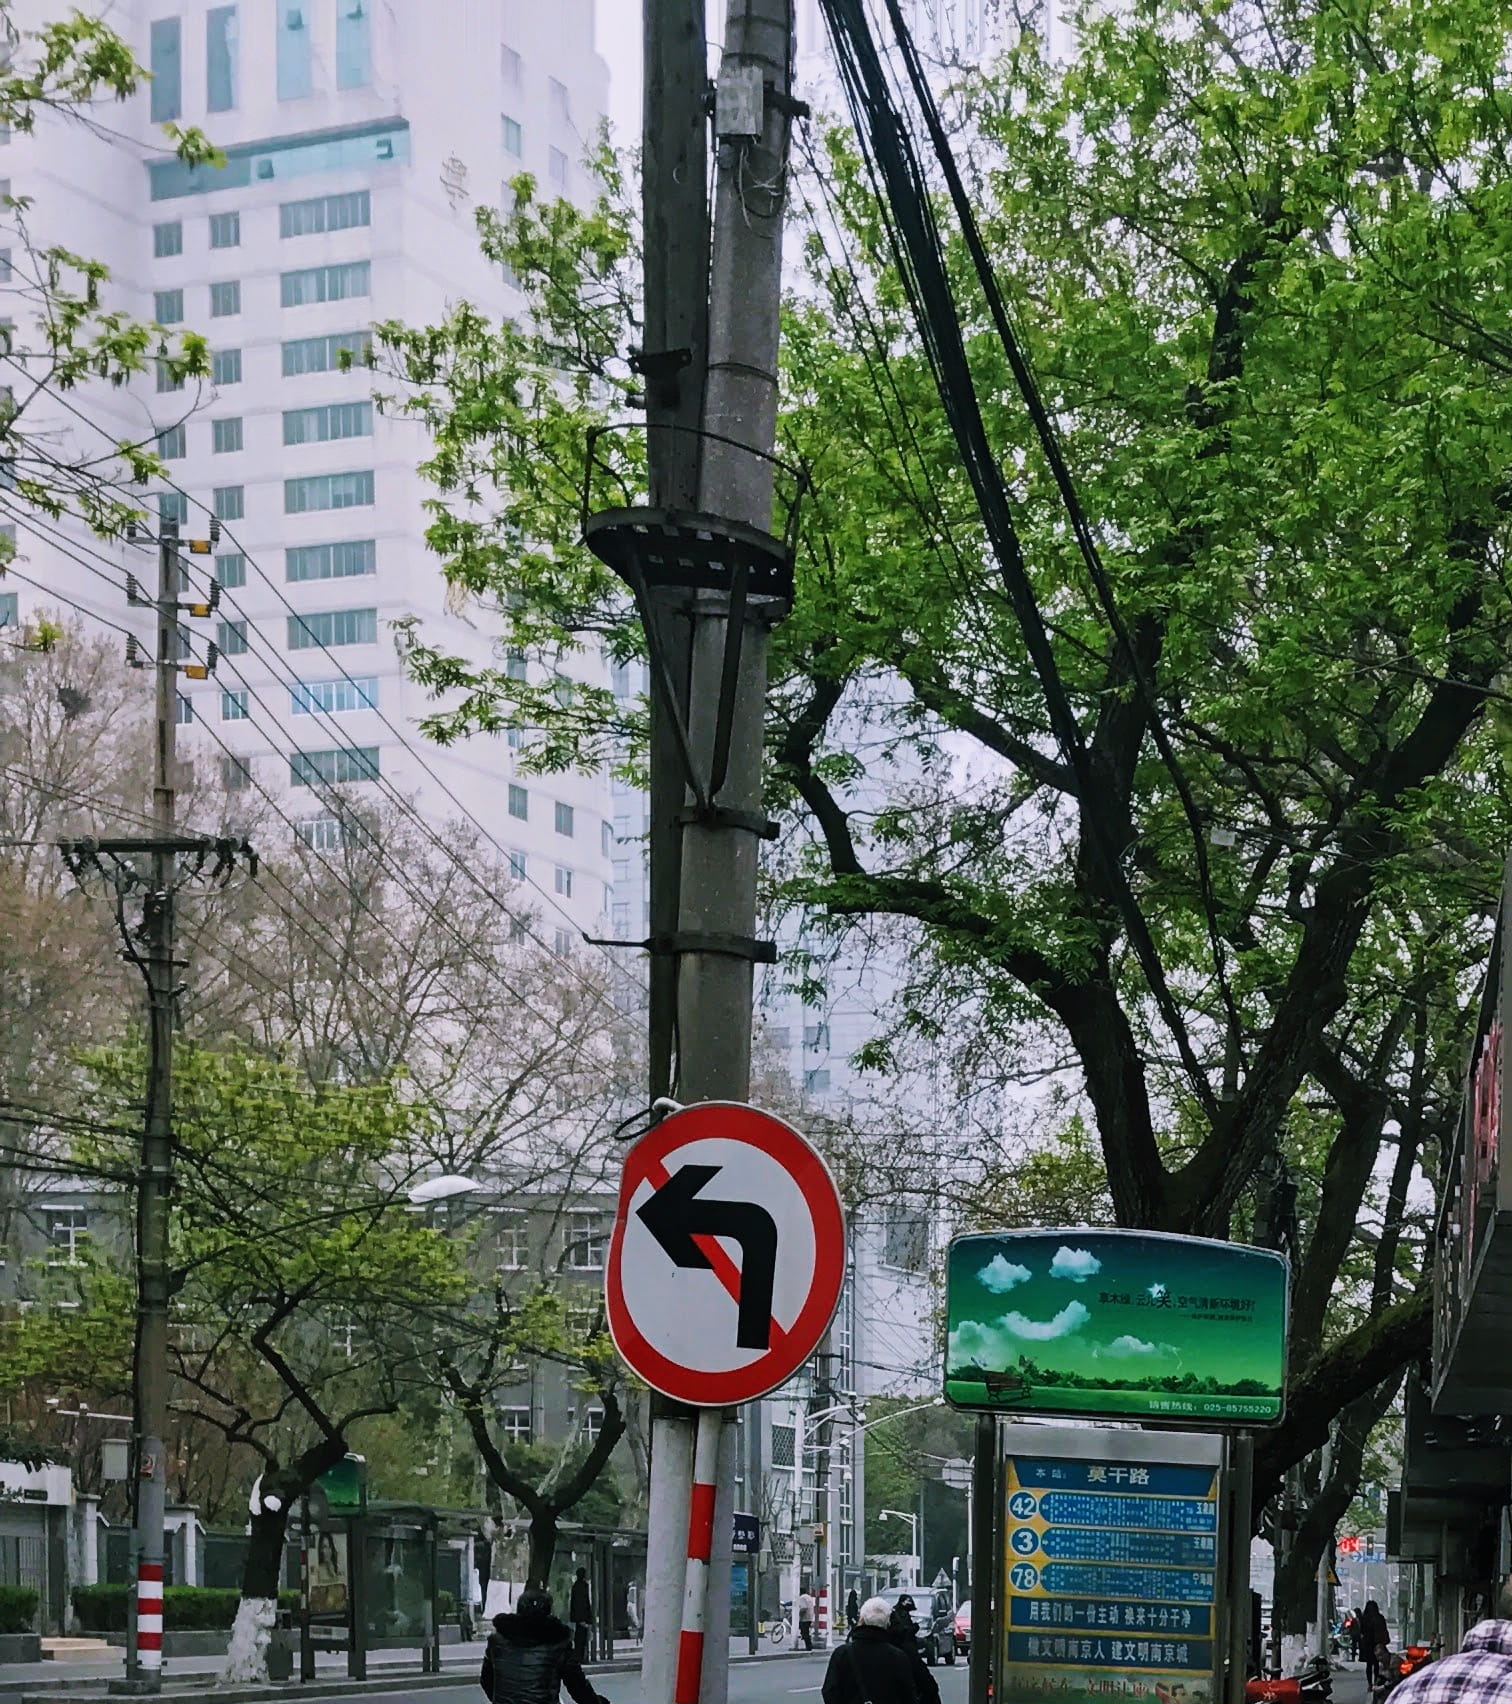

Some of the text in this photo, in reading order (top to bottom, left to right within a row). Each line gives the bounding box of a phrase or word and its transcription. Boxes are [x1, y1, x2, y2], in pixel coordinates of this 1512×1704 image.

[1087, 1466, 1151, 1486] 莫干路
[1012, 1497, 1035, 1516] 42
[1018, 1532, 1033, 1551] 3
[1014, 1567, 1035, 1587] 78
